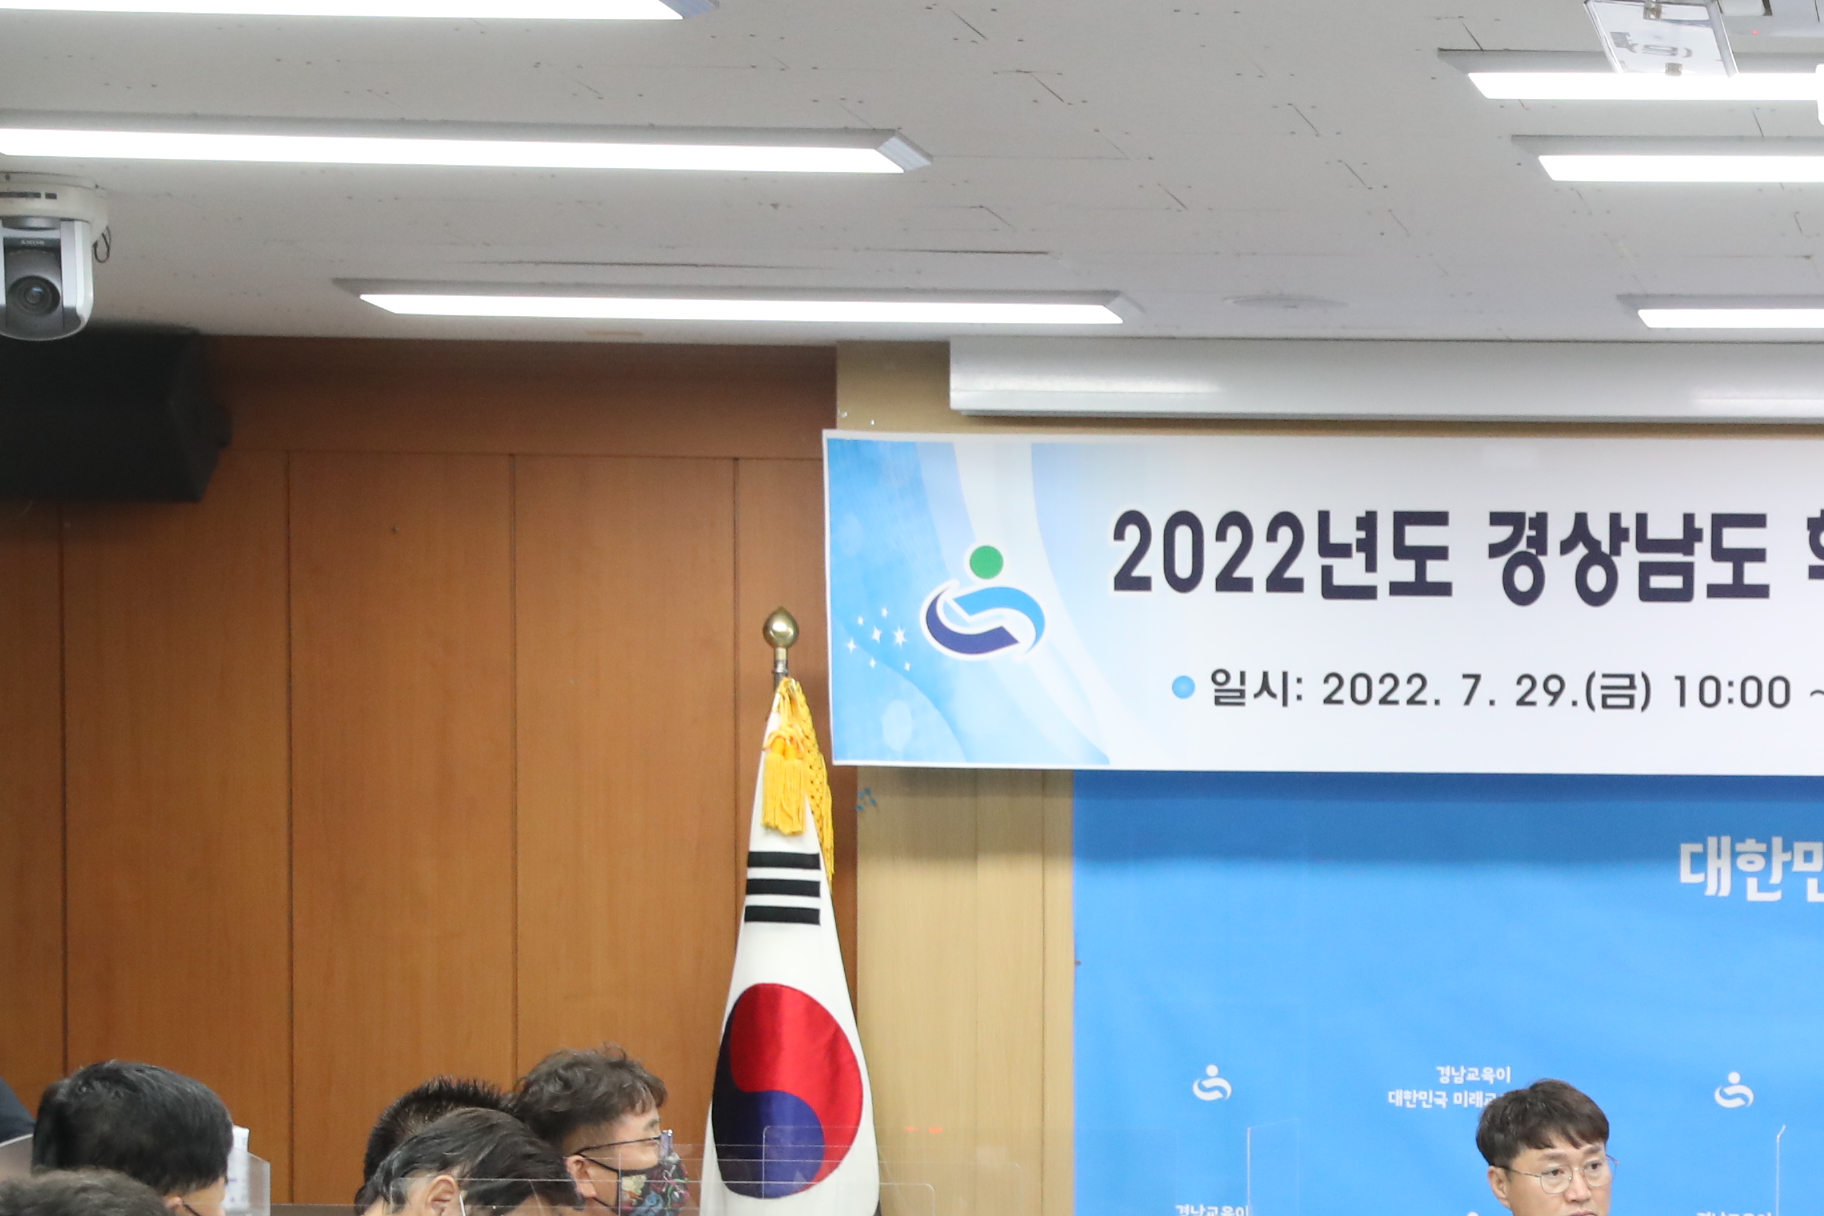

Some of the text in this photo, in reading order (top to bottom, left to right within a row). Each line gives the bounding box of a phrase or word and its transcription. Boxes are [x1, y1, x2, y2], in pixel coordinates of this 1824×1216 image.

[1113, 510, 1453, 600] 2022년도
[1488, 511, 1770, 607] 경상남도
[1210, 667, 1303, 707] 일시:
[1322, 672, 1441, 706] 2022.
[1462, 673, 1496, 706] 7.
[1515, 671, 1653, 713] 29.(금)
[1674, 675, 1792, 709] 10:00
[1436, 1065, 1512, 1084] 경남교육이
[1387, 1089, 1449, 1108] 대한민국
